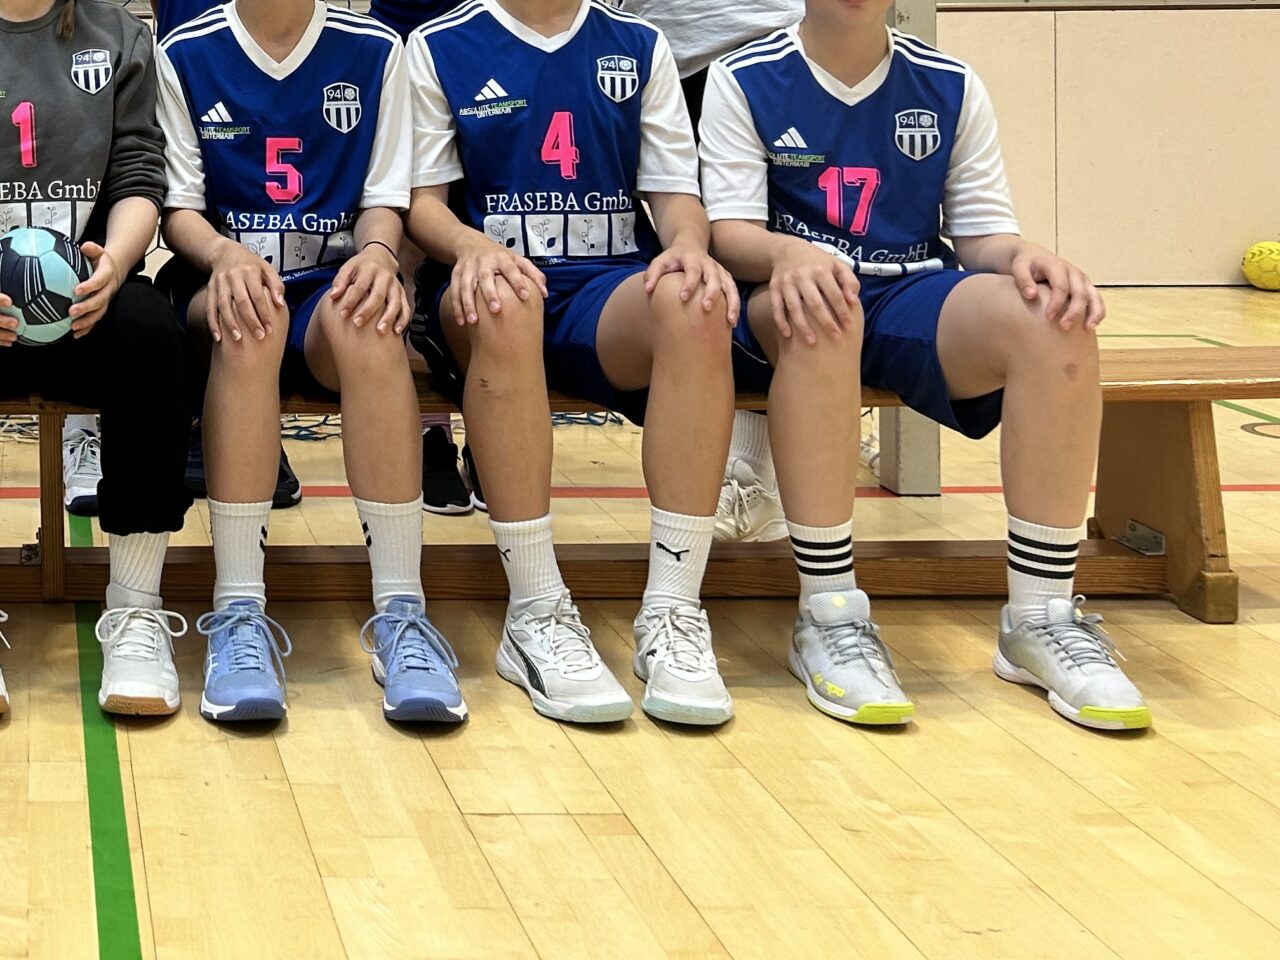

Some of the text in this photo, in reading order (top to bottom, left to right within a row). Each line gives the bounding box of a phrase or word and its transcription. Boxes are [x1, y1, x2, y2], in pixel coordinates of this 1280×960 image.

[76, 54, 91, 63] 94
[601, 60, 617, 70] 94
[327, 89, 342, 100] 94
[899, 116, 915, 126] 94
[11, 101, 37, 168] 1
[541, 111, 580, 179] 4
[265, 137, 303, 204] 5
[47, 178, 101, 199] Gmb
[485, 192, 580, 213] FRASEBA
[818, 166, 880, 236] 17
[226, 211, 297, 230] ASEBA
[869, 242, 929, 263] GmbH
